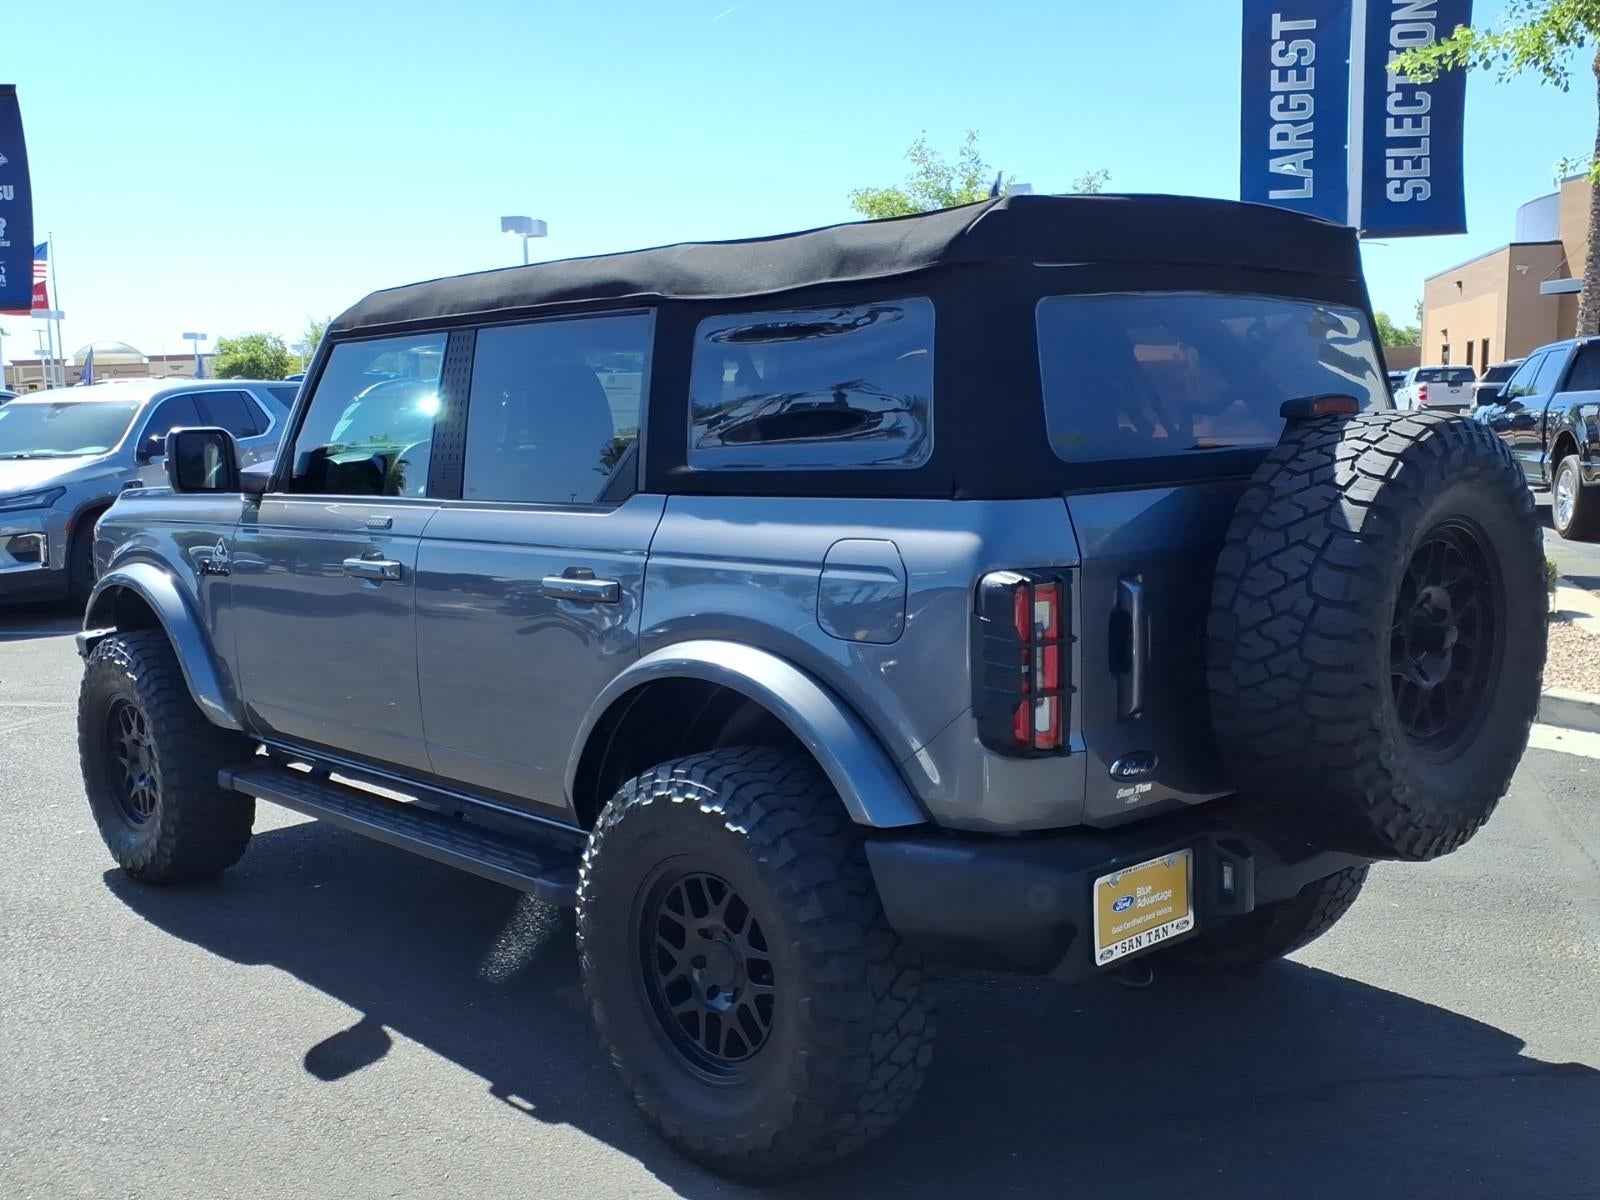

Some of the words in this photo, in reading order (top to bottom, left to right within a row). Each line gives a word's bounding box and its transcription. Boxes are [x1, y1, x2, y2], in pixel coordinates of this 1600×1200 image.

[1269, 13, 1317, 200] LARGEST
[1386, 0, 1438, 203] SELECTON
[1136, 886, 1151, 897] Blue
[1136, 890, 1172, 908] Advantage
[1114, 896, 1133, 911] Ford
[1121, 936, 1141, 953] SAN
[1146, 926, 1168, 943] TAN
